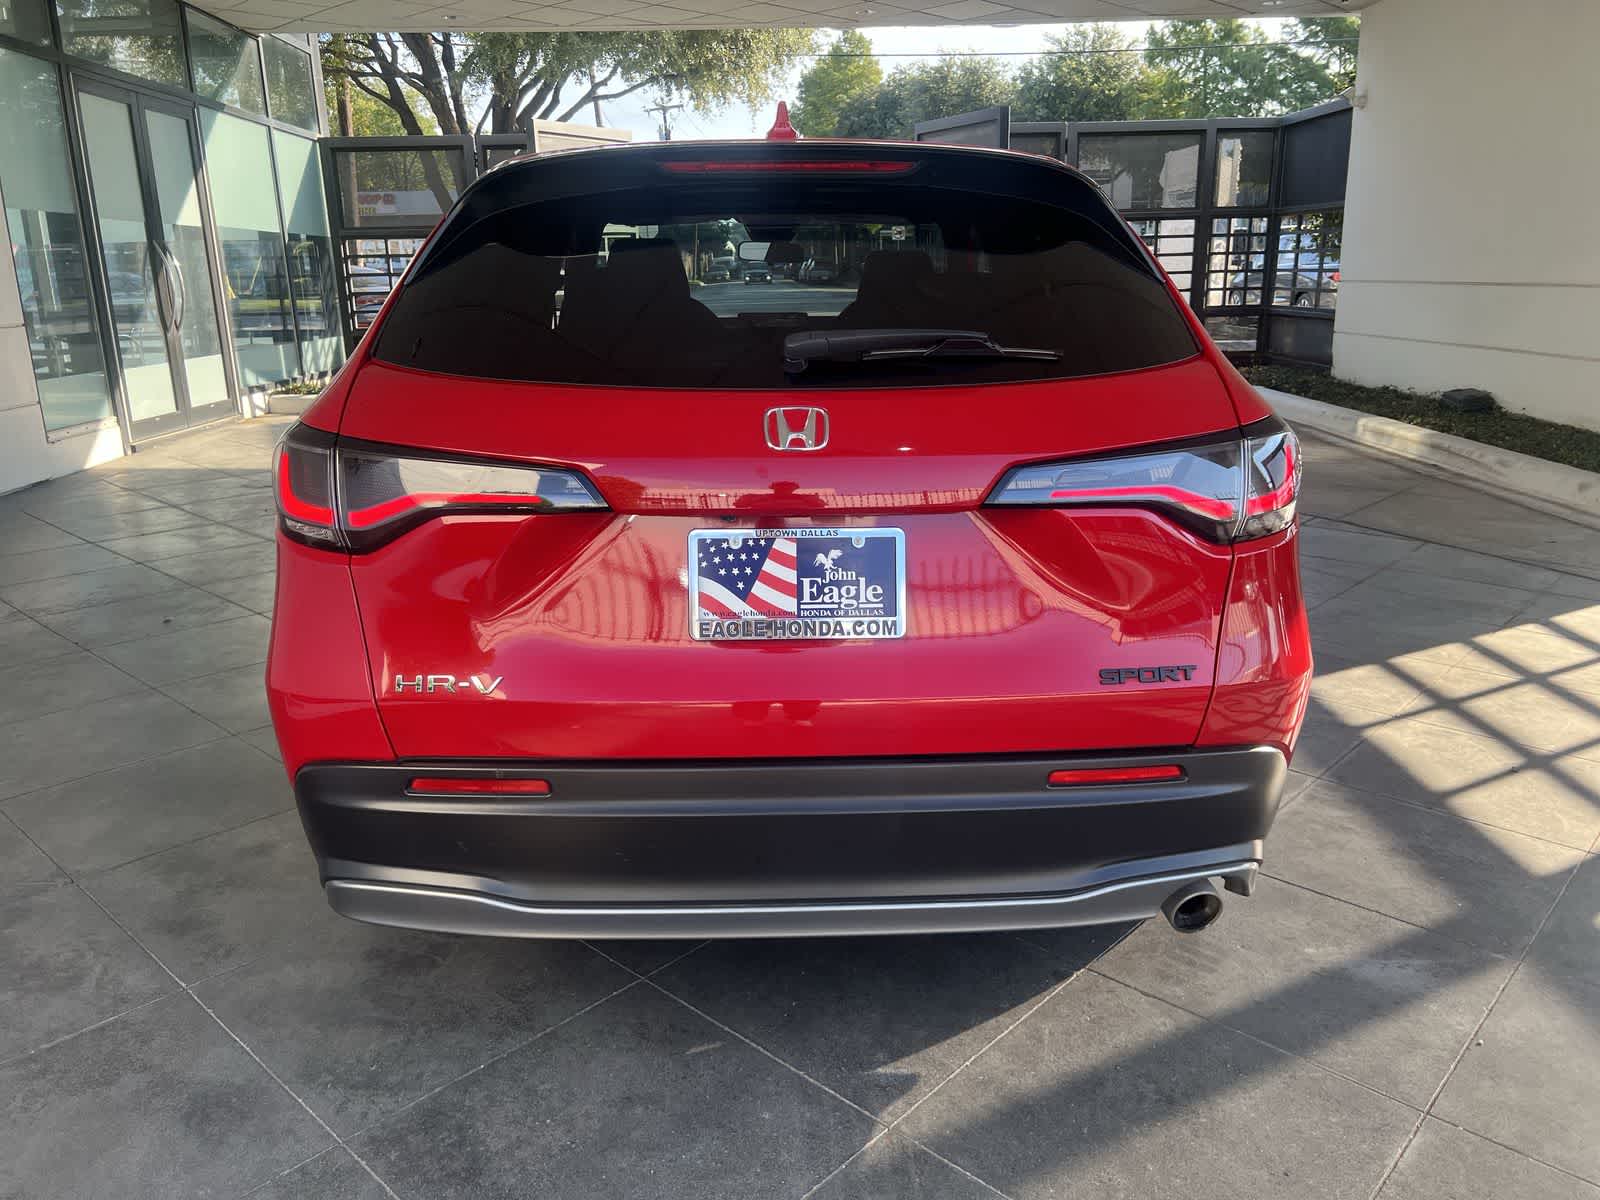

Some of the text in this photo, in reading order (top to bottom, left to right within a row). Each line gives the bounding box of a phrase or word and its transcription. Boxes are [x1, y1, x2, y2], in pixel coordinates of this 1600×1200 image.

[755, 529, 839, 537] UPTOWN DALLAS
[823, 568, 857, 584] John
[800, 577, 884, 610] Eagle
[800, 609, 884, 617] HONDA OF DALLAS
[1099, 665, 1197, 685] SPORT
[395, 675, 504, 694] HR-V
